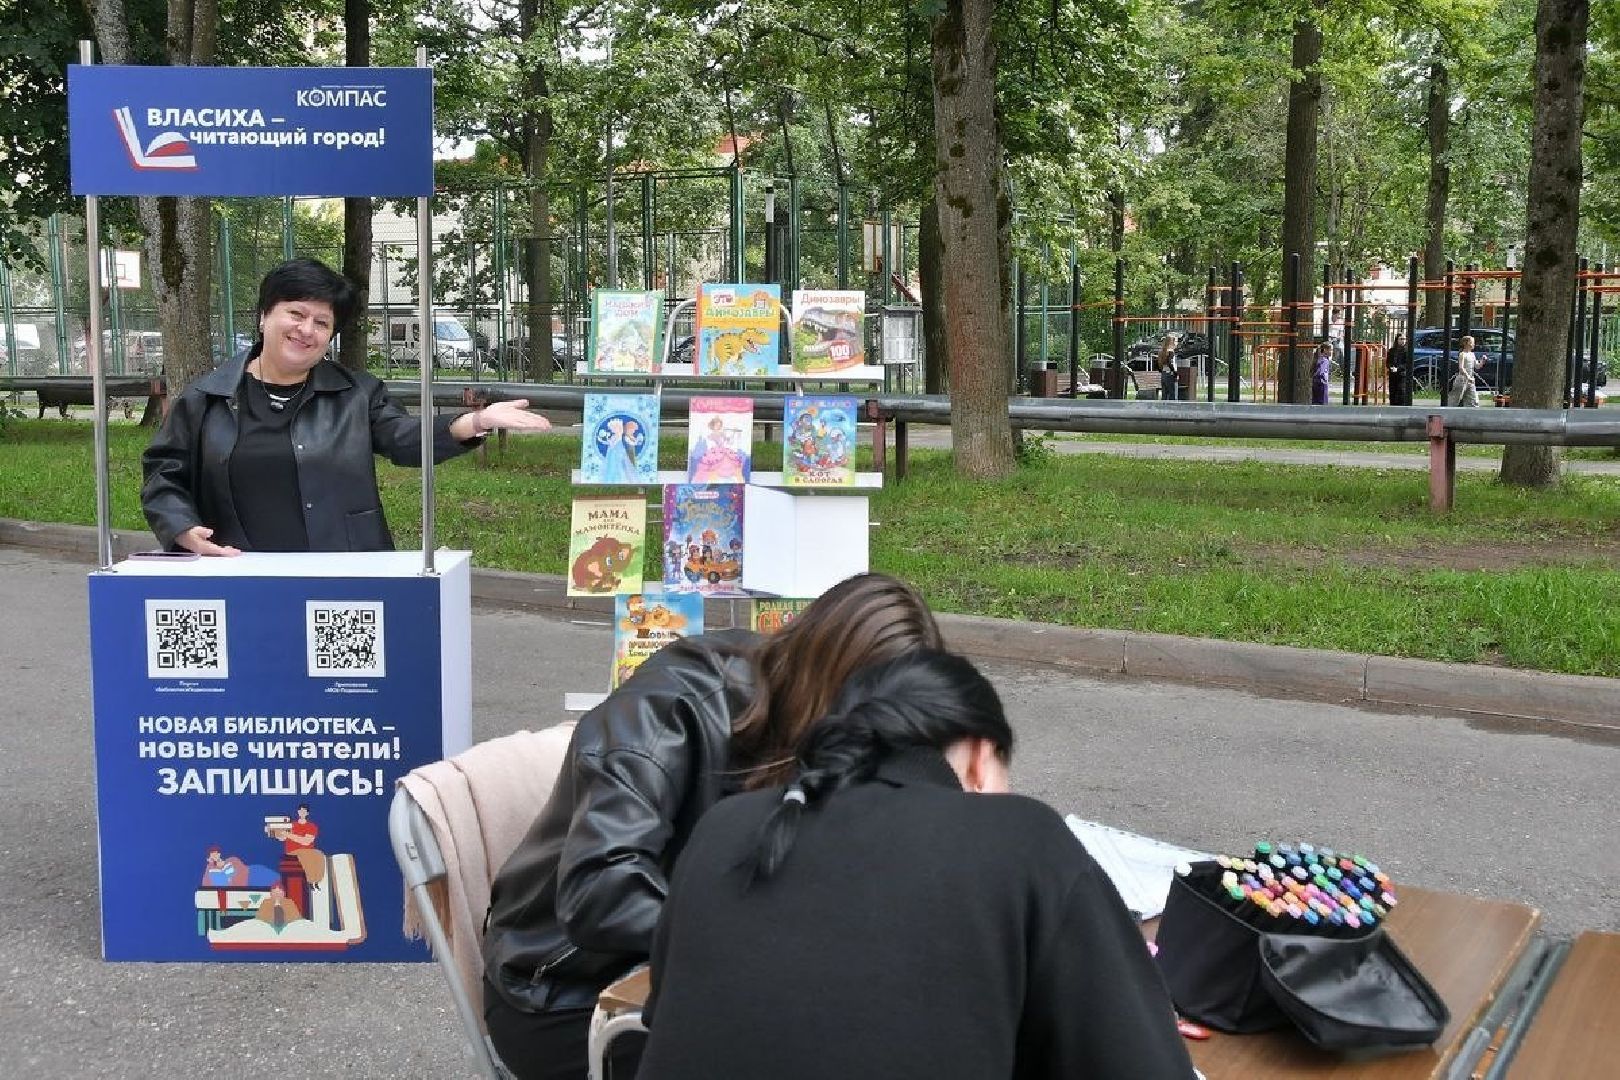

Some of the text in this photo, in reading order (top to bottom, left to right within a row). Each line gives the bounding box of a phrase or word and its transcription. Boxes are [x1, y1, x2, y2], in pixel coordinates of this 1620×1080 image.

[297, 89, 387, 107] КОМПАС
[147, 108, 265, 127] ВЛАСИХА
[190, 127, 385, 147] читающий город!
[800, 294, 860, 306] Динозавры
[706, 308, 775, 318] ДИНОЗАВРЫ
[830, 344, 850, 356] 100
[588, 510, 629, 520] МАМА
[139, 717, 217, 734] НОВАЯ
[224, 717, 377, 735] БИБЛИОТЕКА
[139, 737, 401, 759] новые читатели!
[157, 768, 384, 796] ЗАПИШИСЬ!
